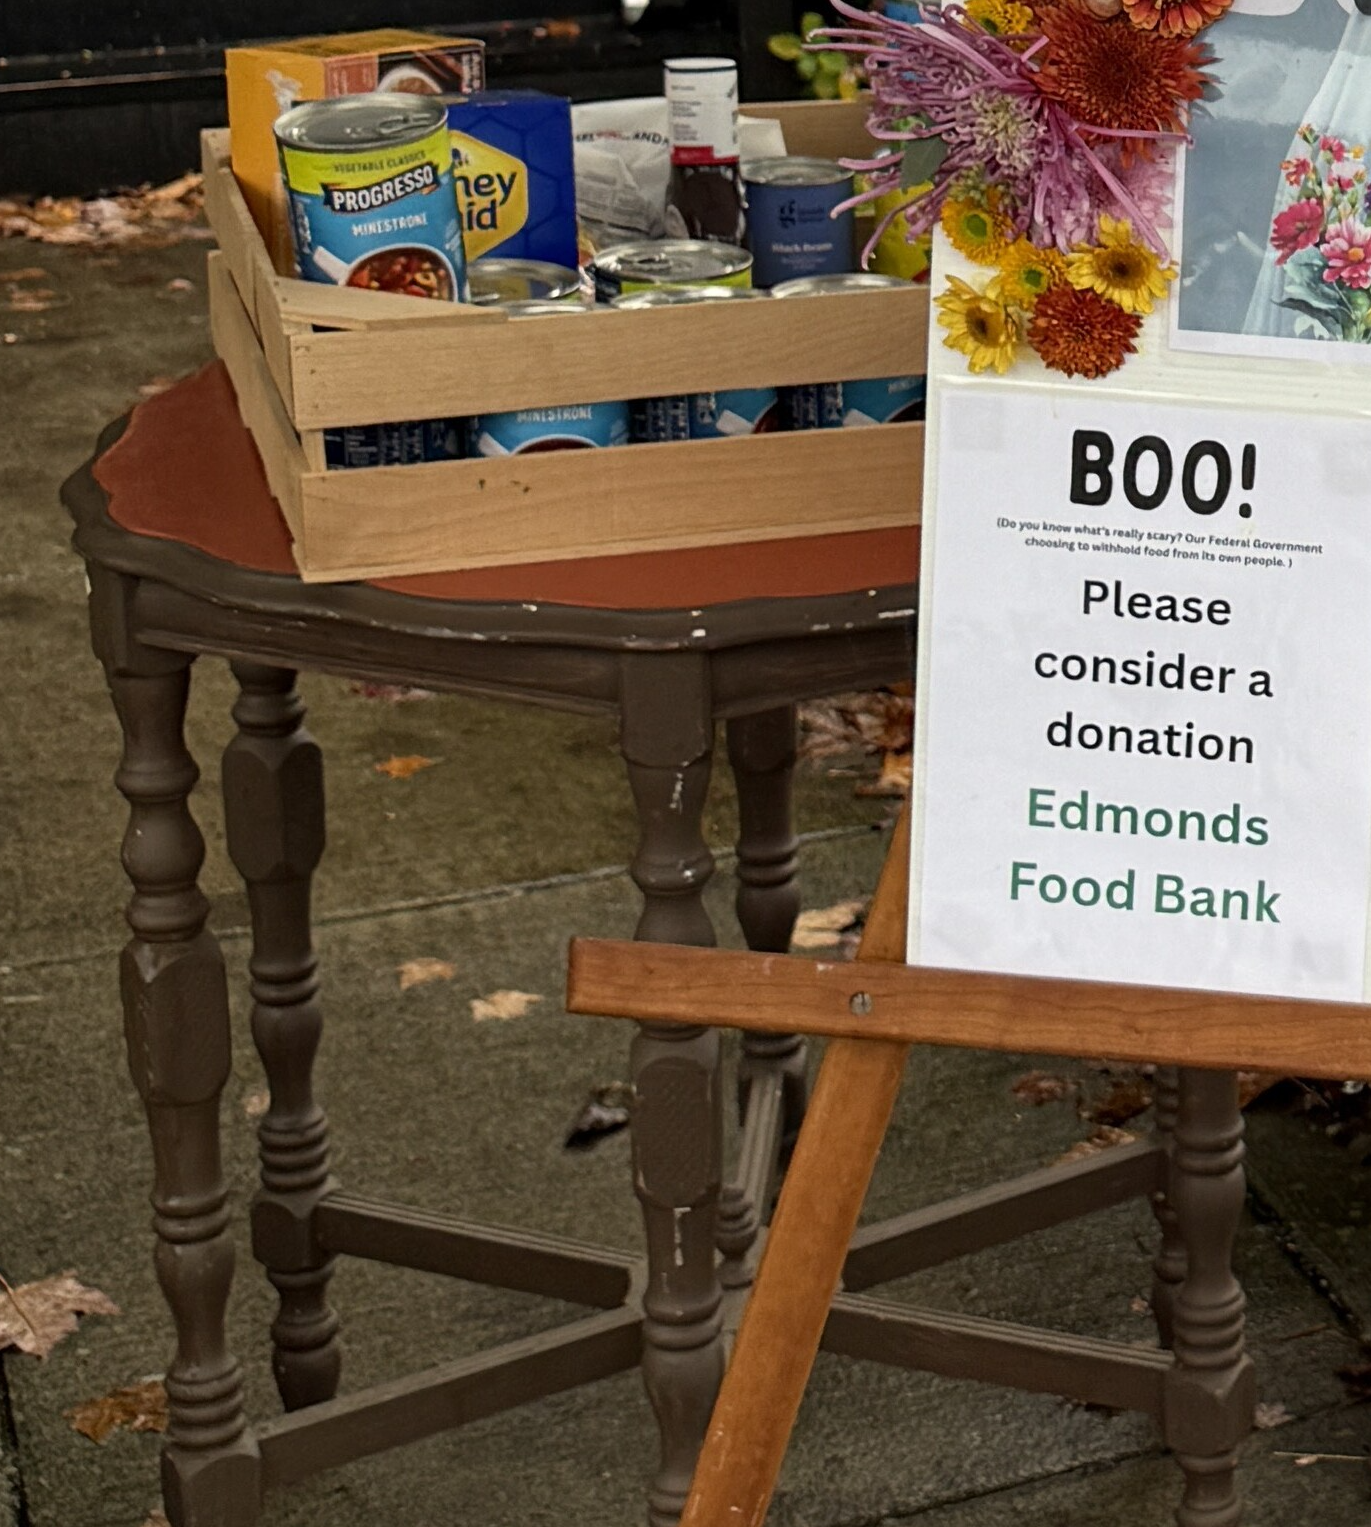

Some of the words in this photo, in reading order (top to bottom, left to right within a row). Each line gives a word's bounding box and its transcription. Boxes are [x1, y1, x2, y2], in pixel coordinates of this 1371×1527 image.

[332, 165, 434, 211] PROGRESSO
[454, 171, 518, 207] ney
[351, 212, 428, 236] MINESTRONE
[1069, 429, 1257, 519] BOO!
[1019, 522, 1040, 532] you
[1042, 522, 1072, 533] know
[1074, 524, 1111, 536] what's
[1113, 527, 1145, 541] really
[1147, 531, 1182, 544] scary?
[1185, 533, 1206, 544] Our
[1208, 535, 1251, 548] Federal
[1253, 538, 1323, 554] Government
[1025, 537, 1075, 552] choosing
[1078, 540, 1090, 551] to
[1092, 542, 1141, 555] withhold
[1144, 545, 1170, 557] food
[1173, 548, 1199, 560] from
[1202, 550, 1216, 561] its
[1218, 554, 1242, 563] own
[1083, 579, 1231, 625] Please
[1034, 650, 1236, 694] consider
[1248, 669, 1274, 698] a
[1047, 711, 1254, 763] donation
[1028, 788, 1269, 846] Edmonds
[1010, 861, 1136, 910] Food
[1154, 873, 1282, 923] Bank
